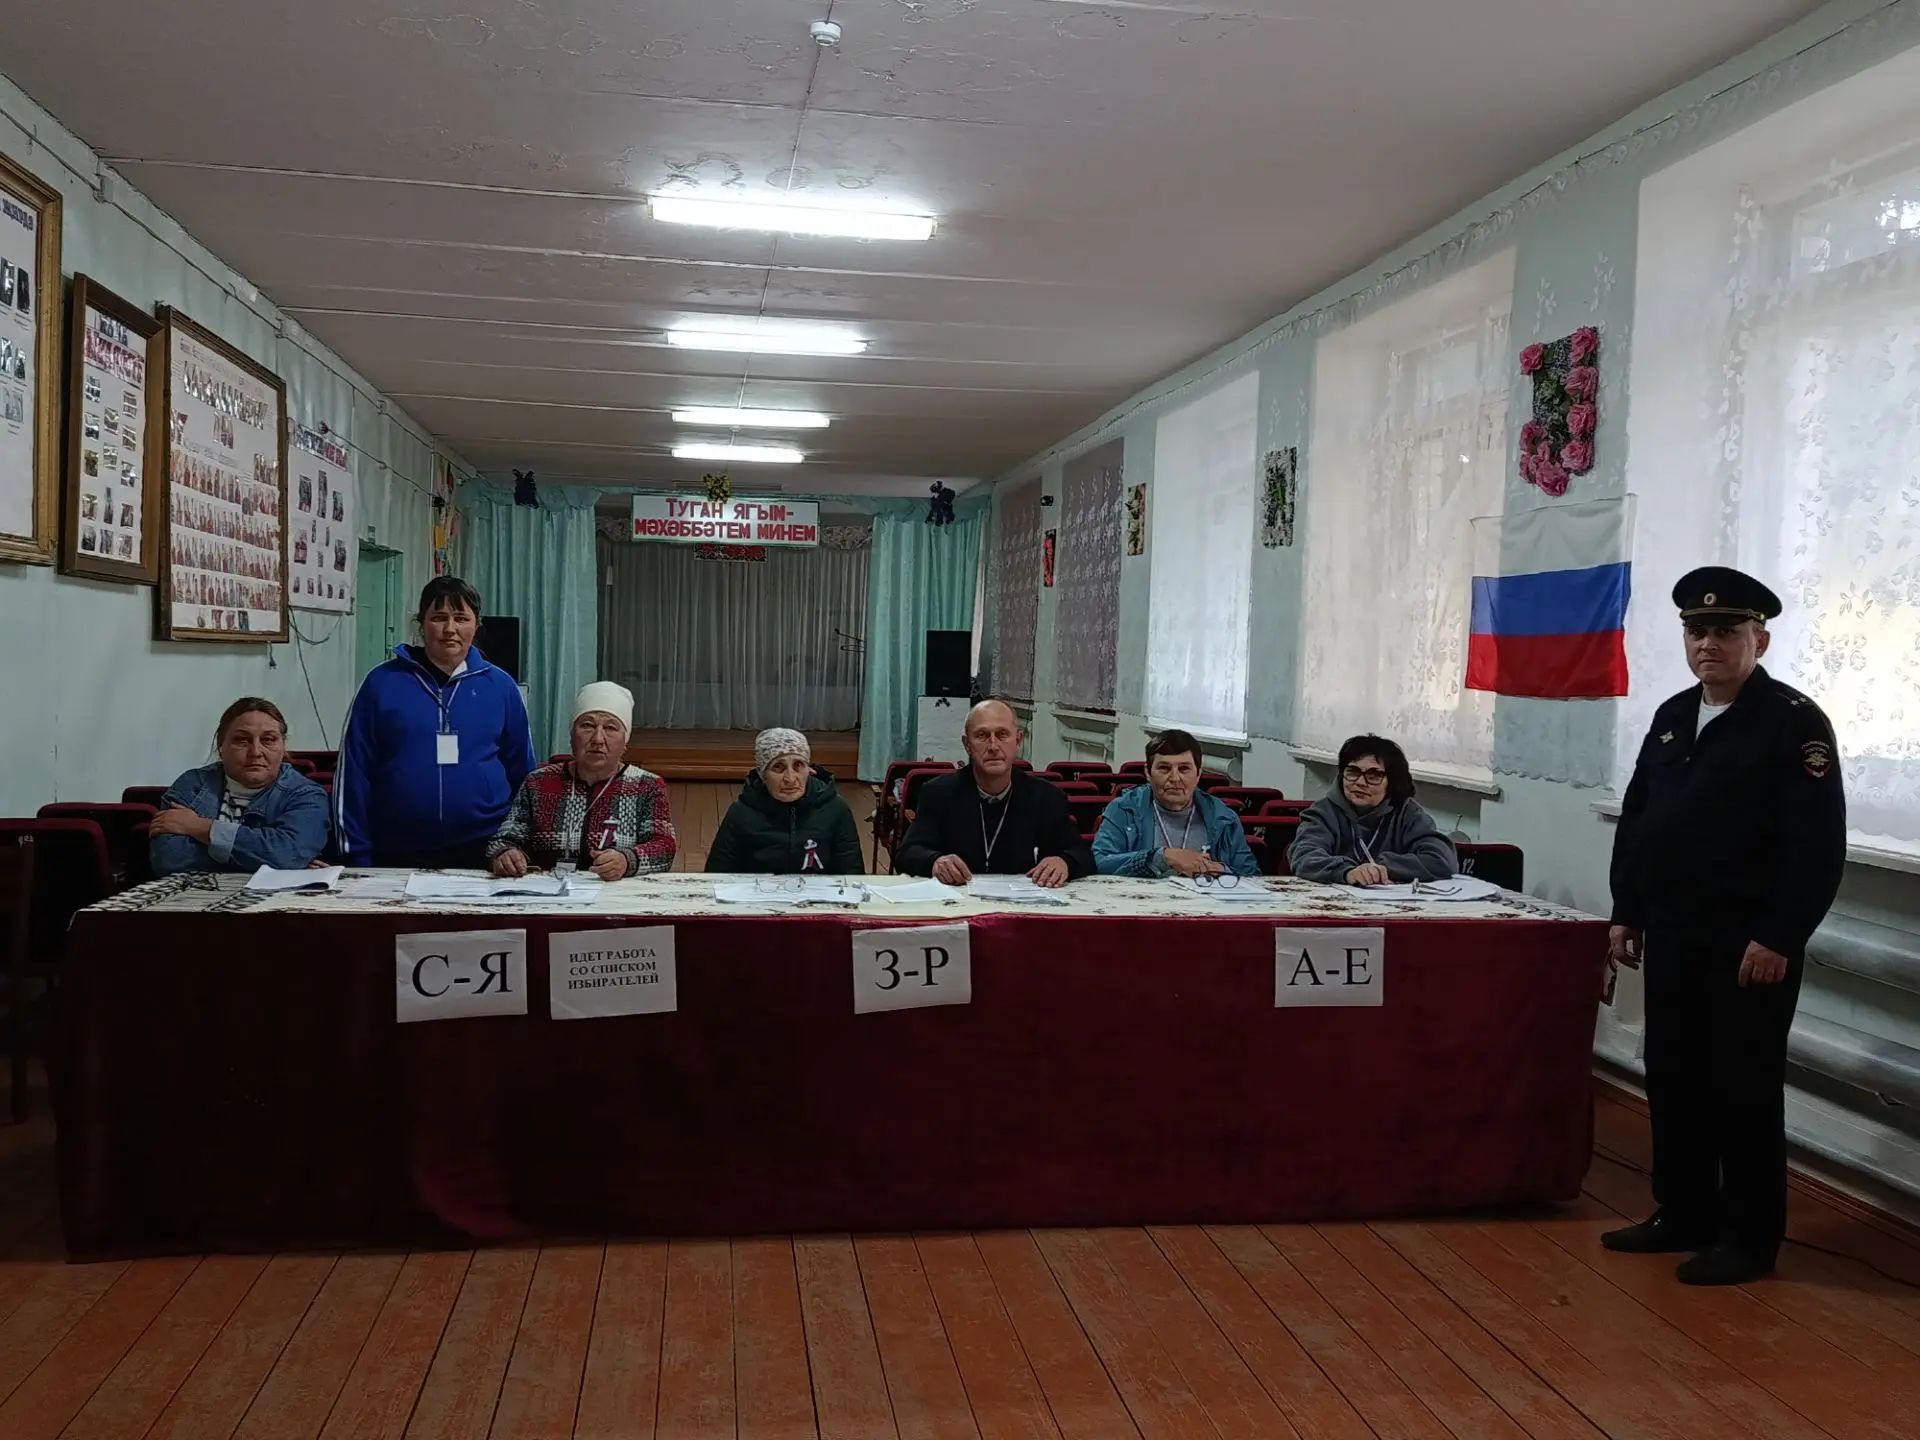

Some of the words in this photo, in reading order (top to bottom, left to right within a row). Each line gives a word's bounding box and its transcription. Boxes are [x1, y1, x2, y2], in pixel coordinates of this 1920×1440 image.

[666, 498, 724, 519] ТУГАН
[734, 503, 794, 521] ЯГЫМ-
[635, 518, 751, 539] МӘХӘББӘТЕМ
[757, 524, 816, 541] МИНЕМ
[569, 951, 604, 963] ИДЕТ
[606, 948, 656, 960] РАБОТА
[1286, 947, 1372, 986] А-Е
[412, 951, 513, 997] С-Я
[570, 966, 588, 976] СО
[591, 961, 656, 974] СПИСКОМ
[874, 946, 949, 990] З-Р
[568, 973, 659, 989] ИЗБИРАТЕЛЕЙ
